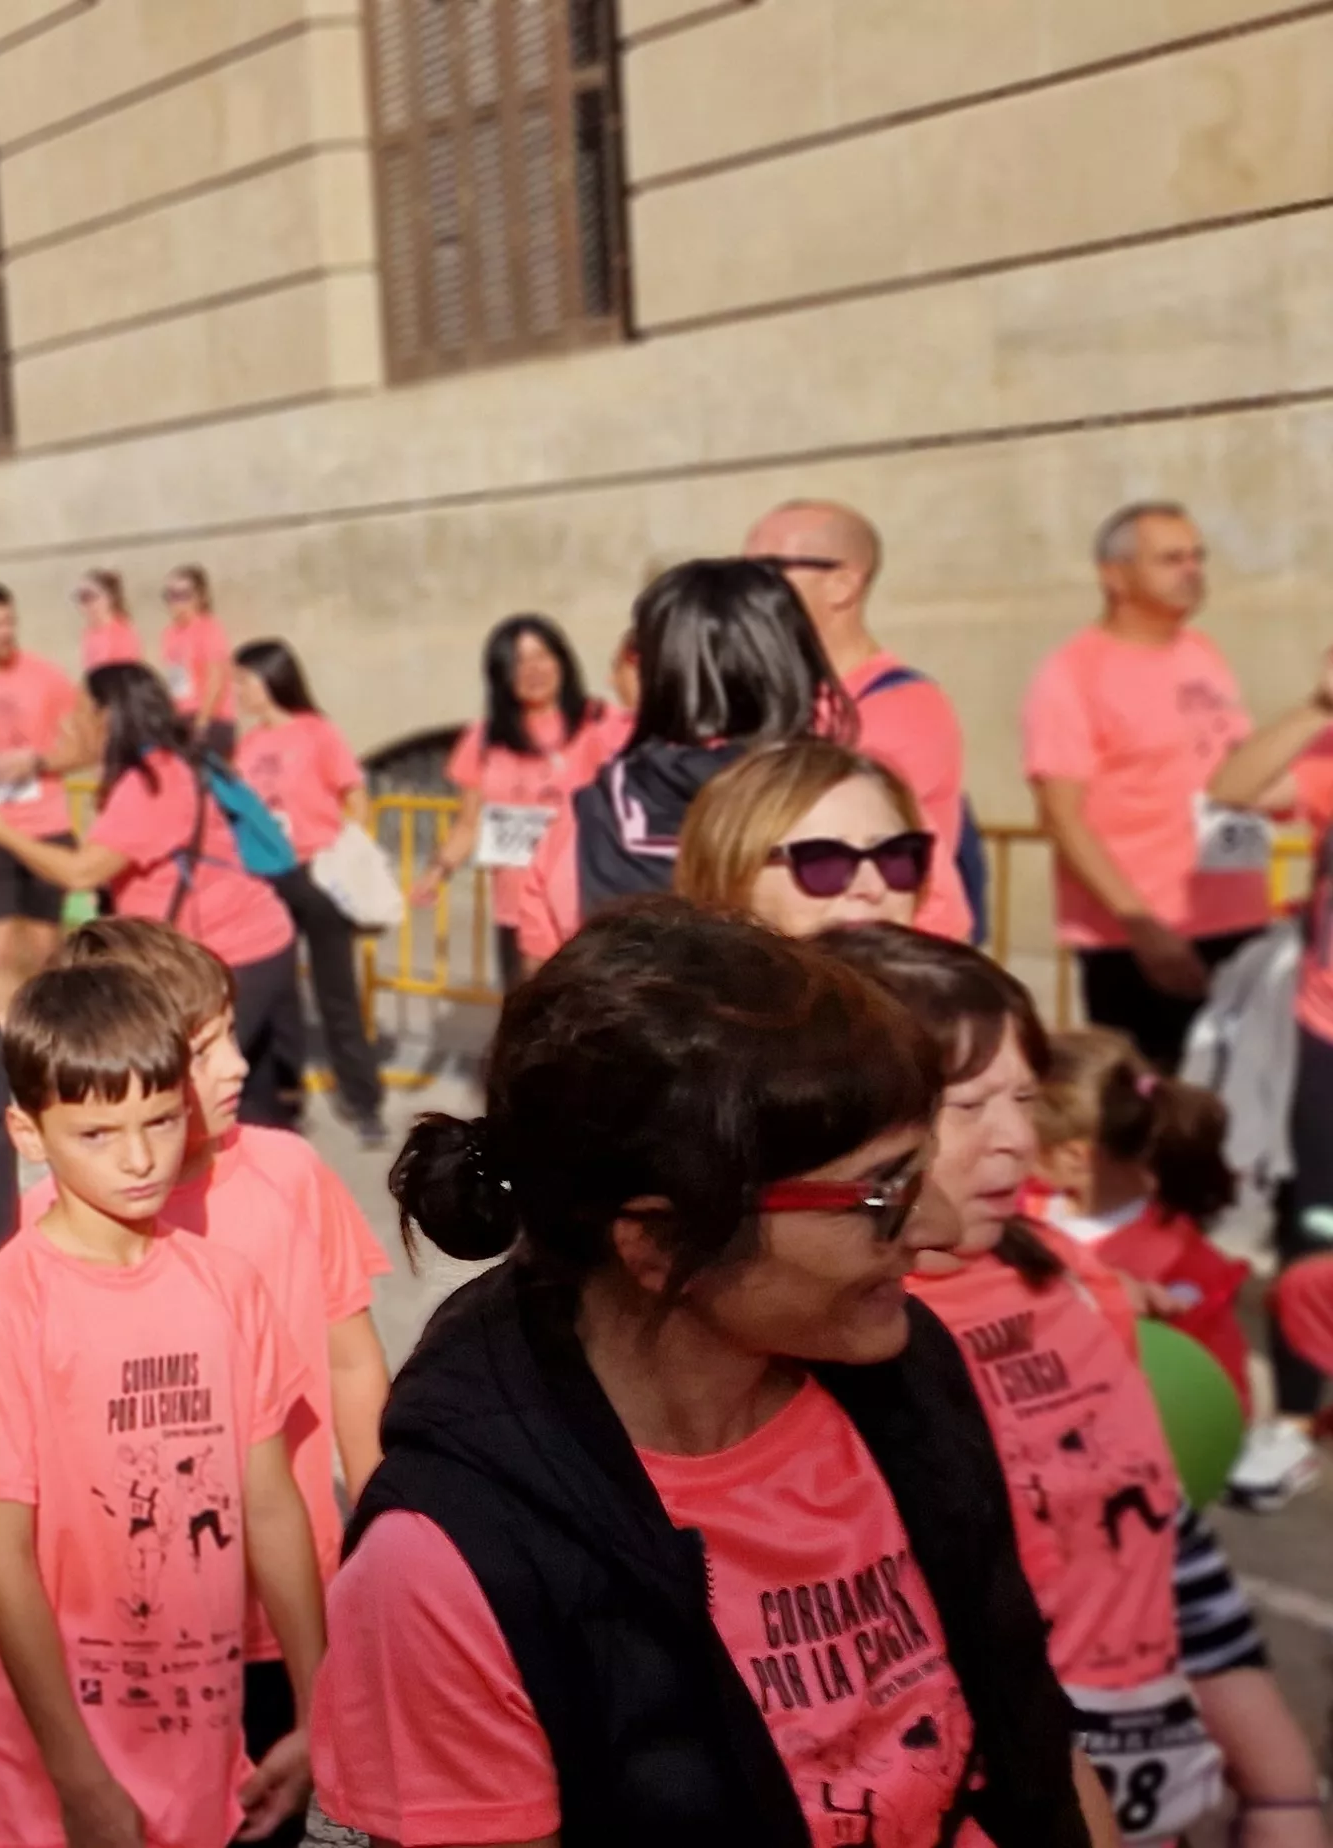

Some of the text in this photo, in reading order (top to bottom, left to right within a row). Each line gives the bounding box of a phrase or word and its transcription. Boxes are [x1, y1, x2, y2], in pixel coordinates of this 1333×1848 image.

[122, 1352, 199, 1395] CORRAMOS
[107, 1396, 137, 1434] POR
[142, 1393, 156, 1429] LA
[158, 1387, 212, 1425] CIENCIA
[750, 1651, 812, 1714] POR
[811, 1643, 855, 1704] LA
